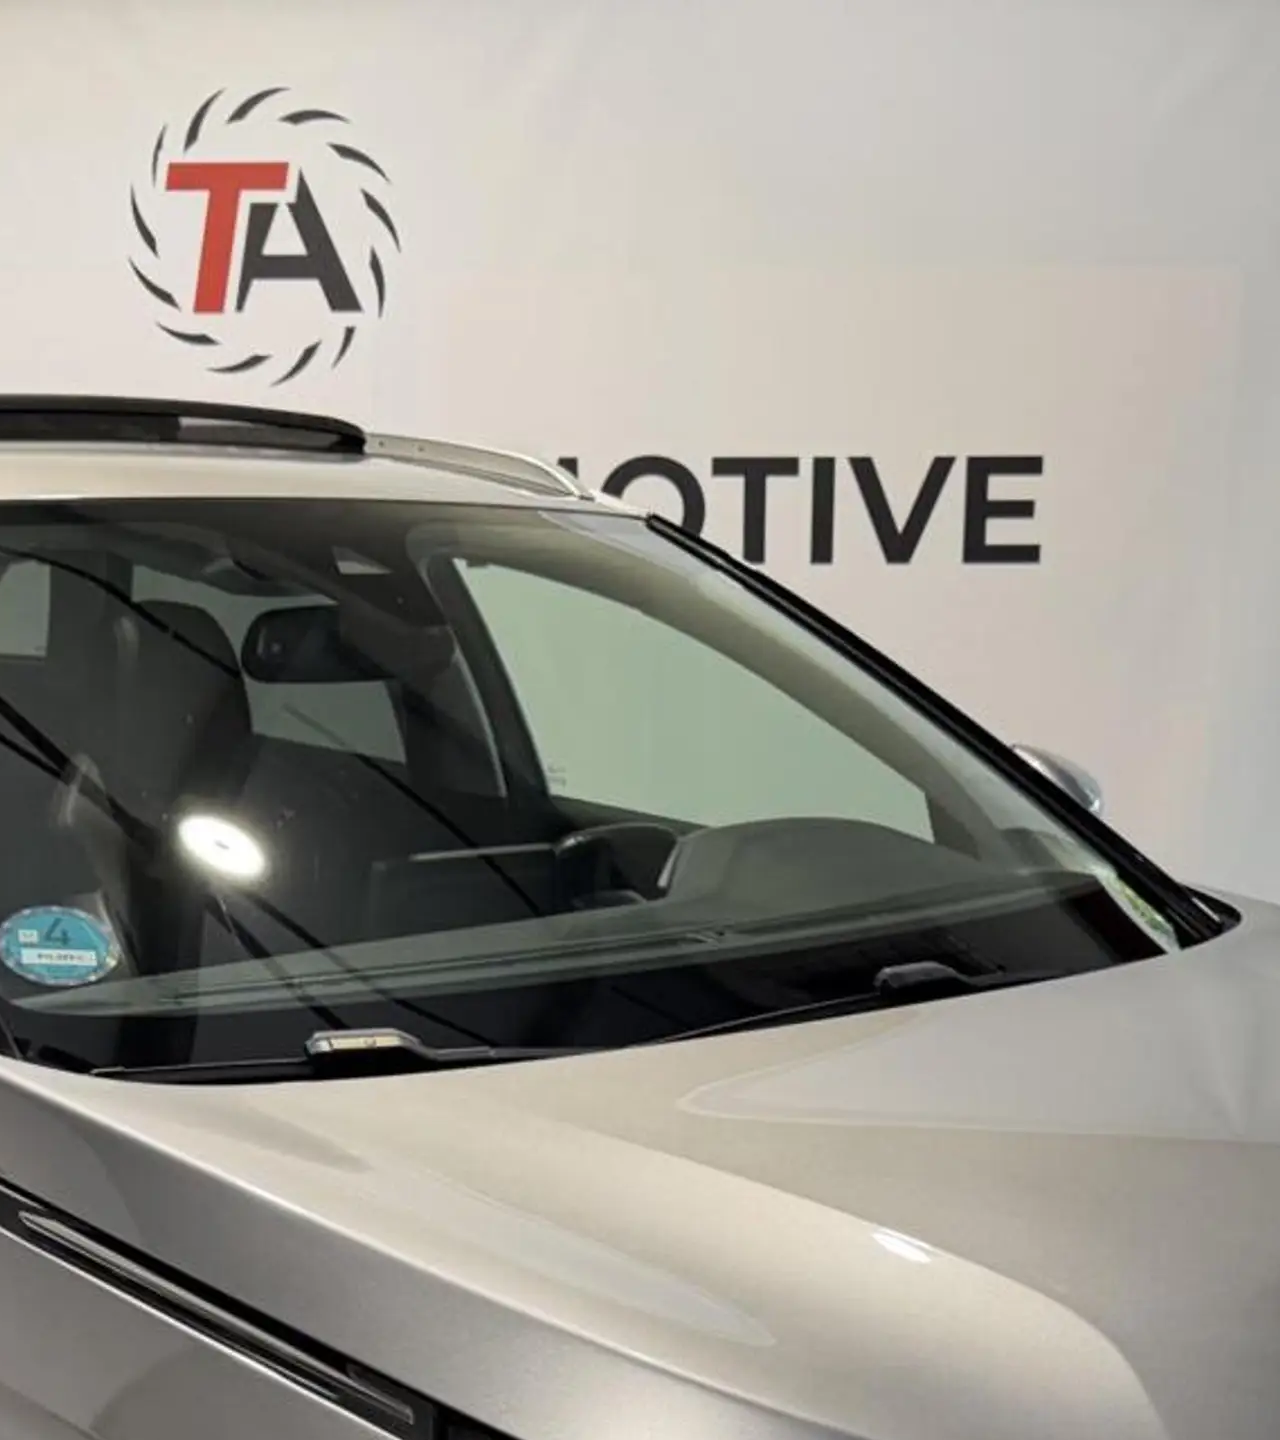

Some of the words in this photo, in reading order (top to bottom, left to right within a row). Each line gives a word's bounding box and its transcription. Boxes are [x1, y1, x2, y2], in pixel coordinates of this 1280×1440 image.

[165, 161, 363, 313] TA
[557, 455, 1043, 564] OTIVE
[45, 917, 69, 946] 4
